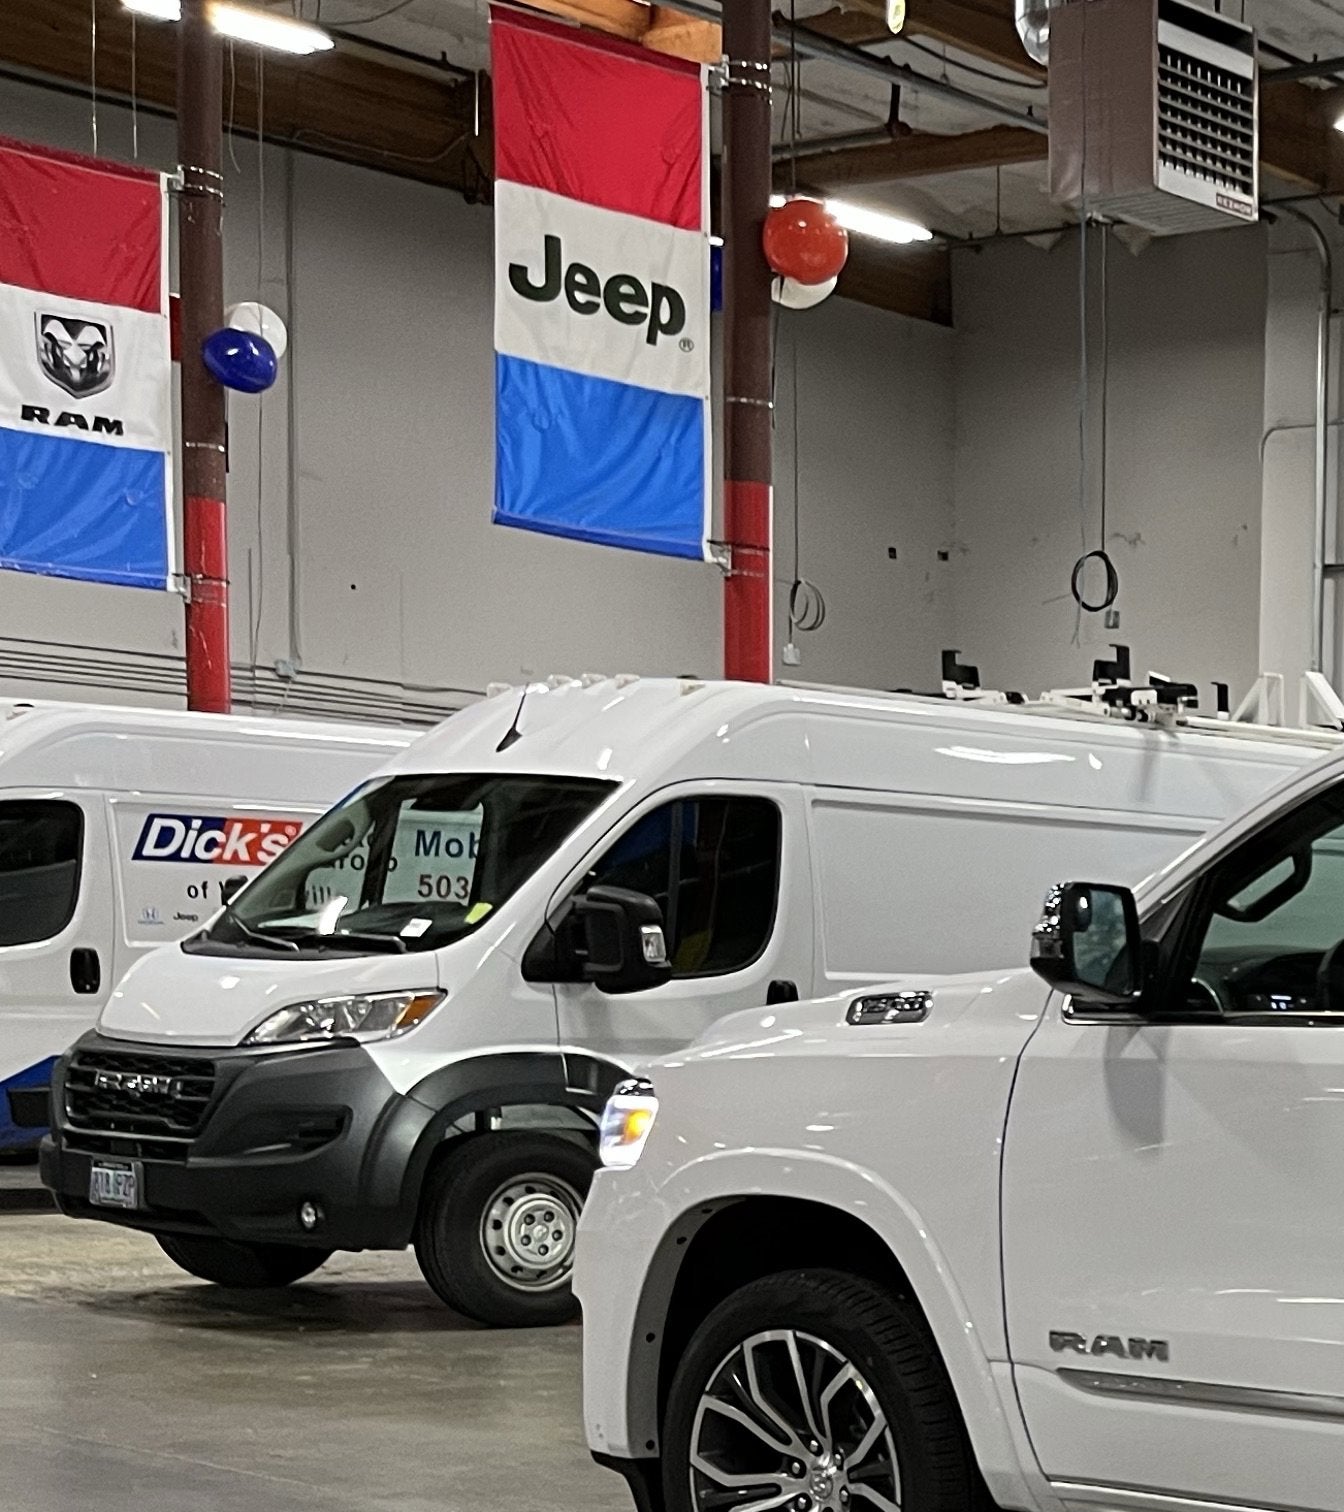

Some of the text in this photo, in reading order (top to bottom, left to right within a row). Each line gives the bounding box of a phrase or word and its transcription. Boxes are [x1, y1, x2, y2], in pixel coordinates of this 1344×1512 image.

[509, 234, 686, 346] Jeep
[21, 404, 124, 436] RAM
[142, 818, 289, 863] Dick's
[187, 881, 208, 899] of
[418, 874, 470, 899] 503
[1049, 1330, 1168, 1362] RAM
